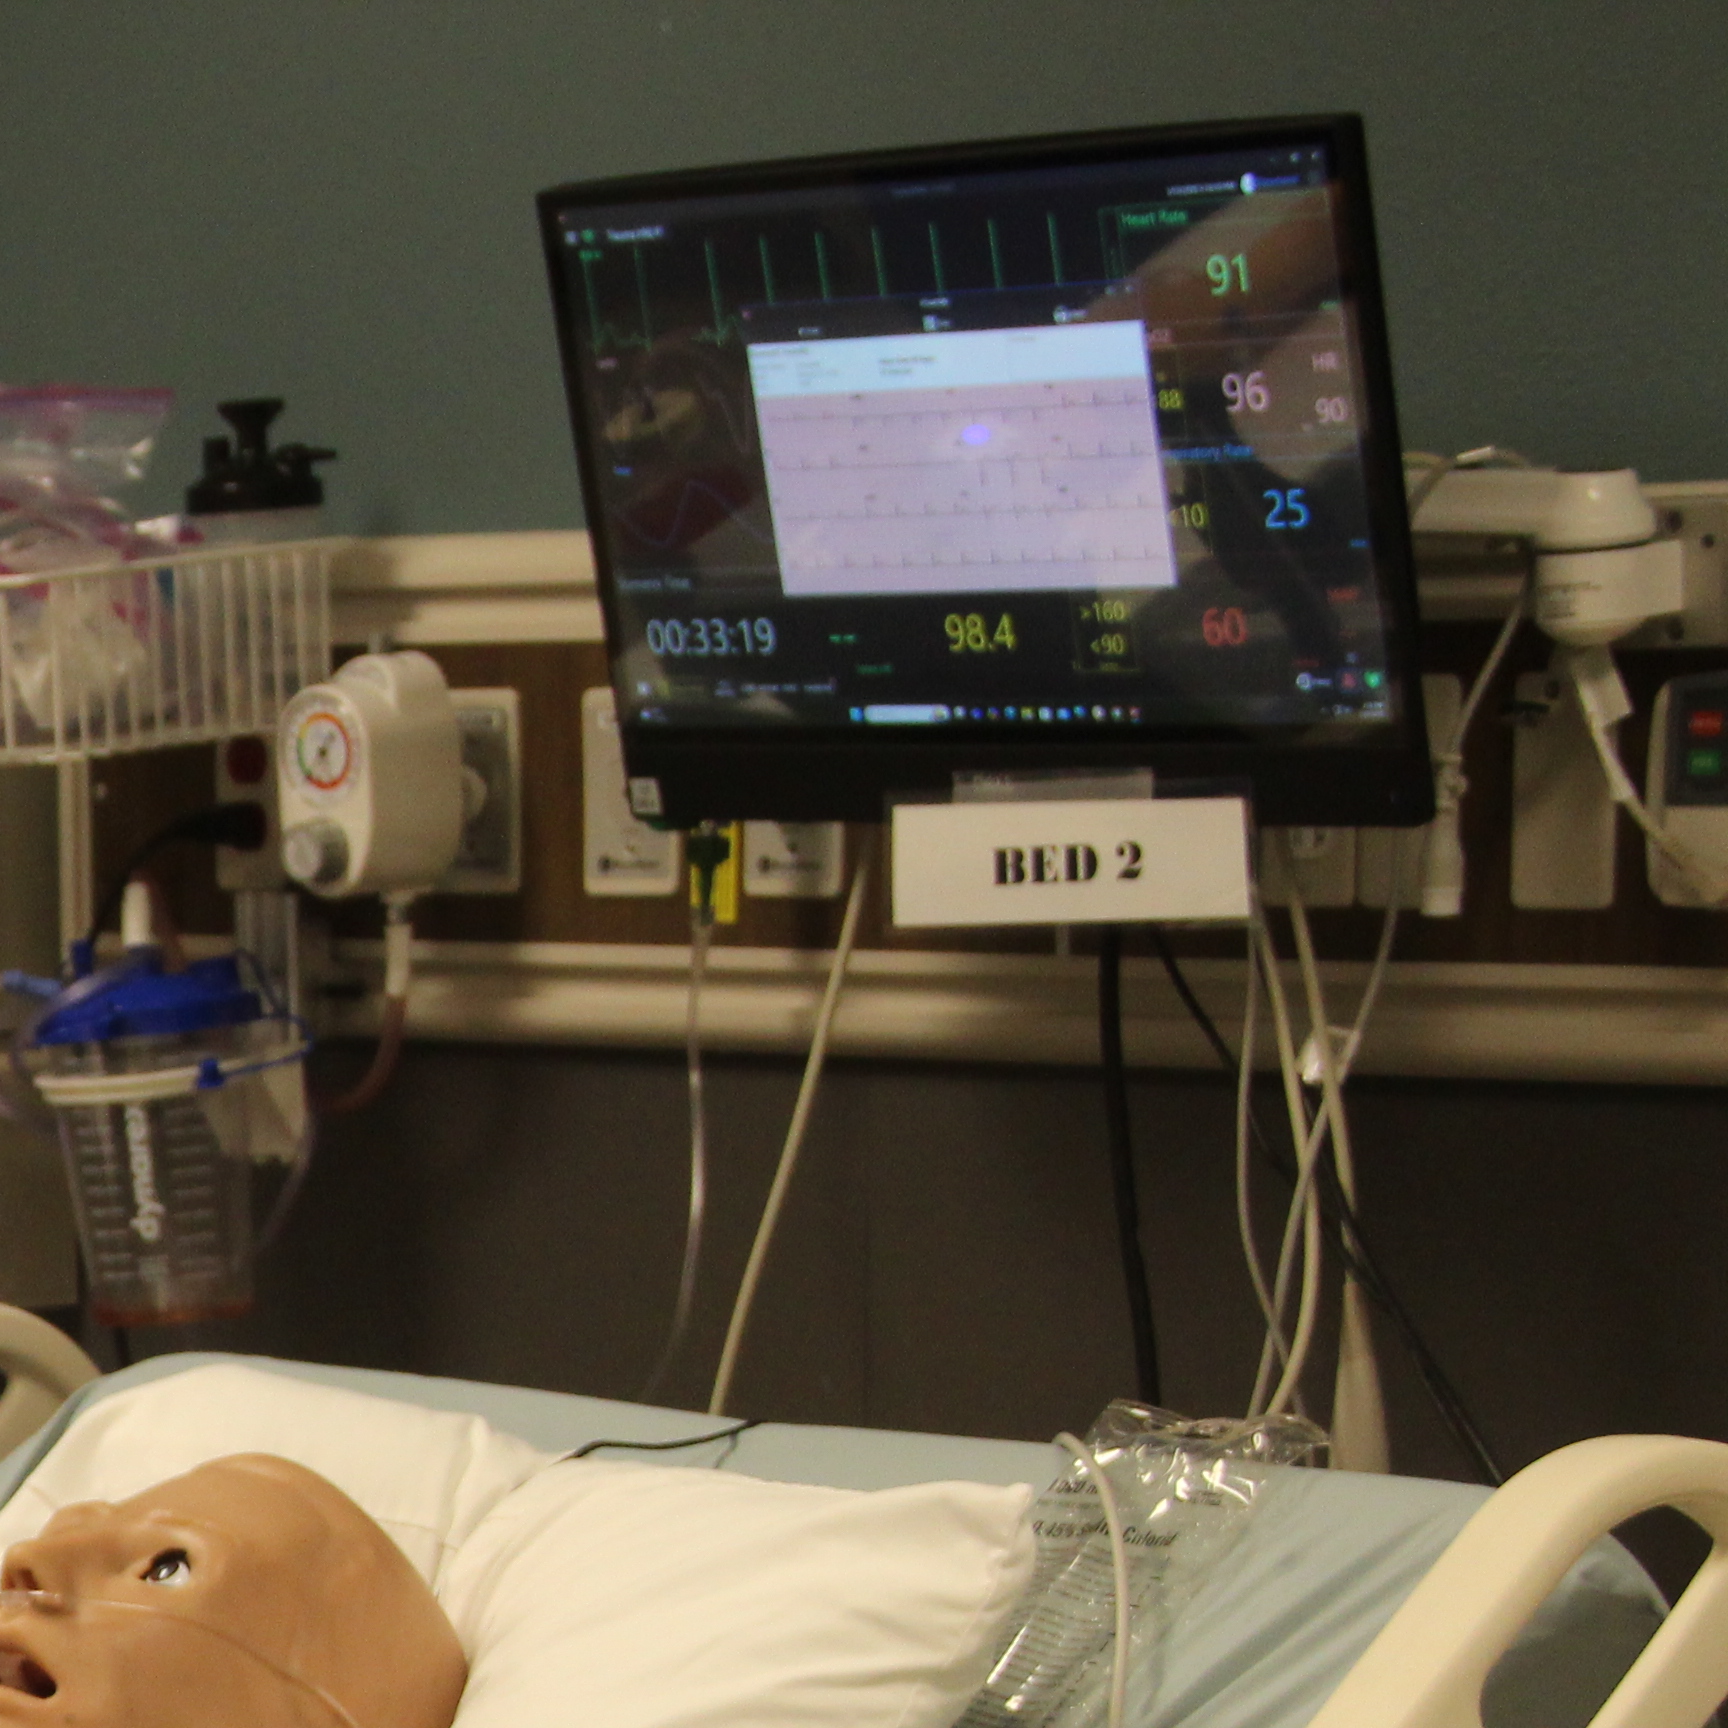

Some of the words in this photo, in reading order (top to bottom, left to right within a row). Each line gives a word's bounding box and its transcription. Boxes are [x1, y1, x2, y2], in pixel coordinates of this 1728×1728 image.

[1205, 253, 1250, 297] 91
[1221, 369, 1271, 413] 96
[1314, 396, 1348, 424] 90
[1262, 487, 1311, 530] 25
[646, 616, 778, 656] 00:33:19
[944, 612, 1017, 652] 98.4
[1201, 606, 1249, 646] 60
[993, 844, 1098, 886] BED
[1114, 840, 1144, 880] 2
